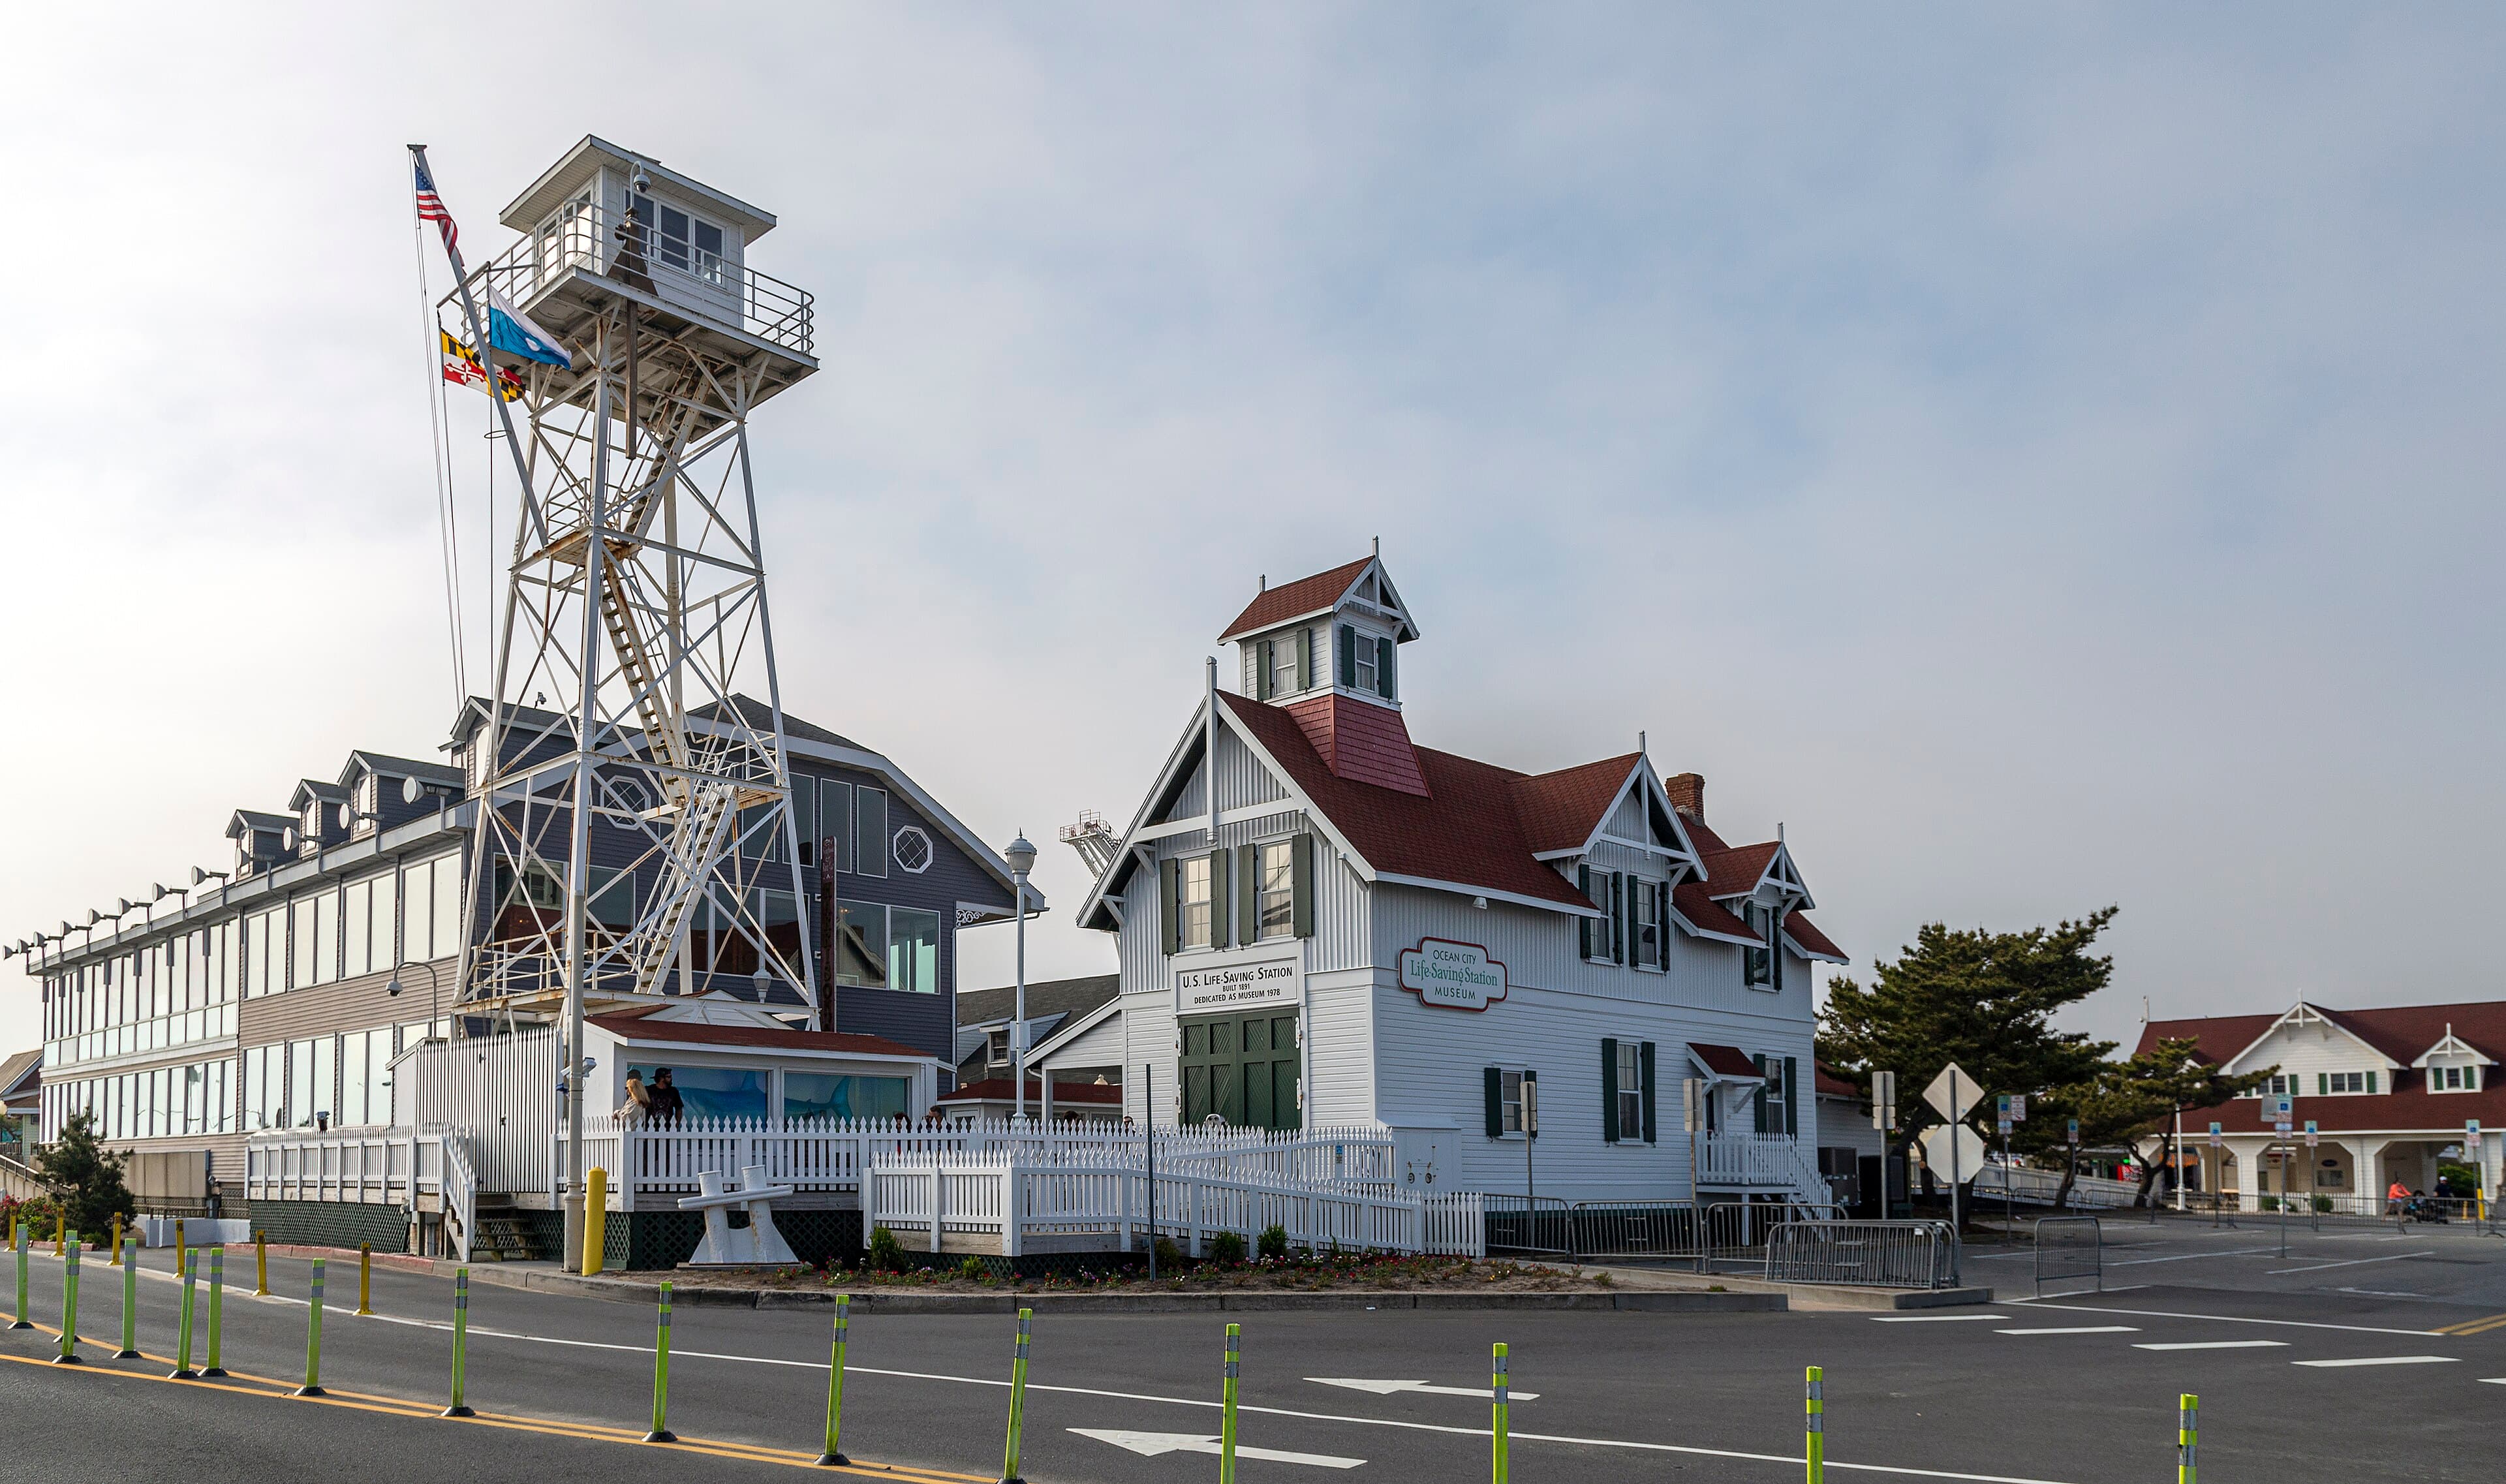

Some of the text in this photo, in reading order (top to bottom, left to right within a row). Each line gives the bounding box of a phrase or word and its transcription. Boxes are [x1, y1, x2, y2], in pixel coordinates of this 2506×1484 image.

[1432, 950, 1477, 965] OCEAN CITY
[1258, 966, 1293, 980] STATION
[1410, 959, 1498, 986] Life-Saving Station
[1194, 994, 1226, 1004] DEDICATED
[1238, 990, 1265, 1000] MUSEUM
[1267, 988, 1280, 997] 1978
[1434, 986, 1476, 1000] MUSEUM
